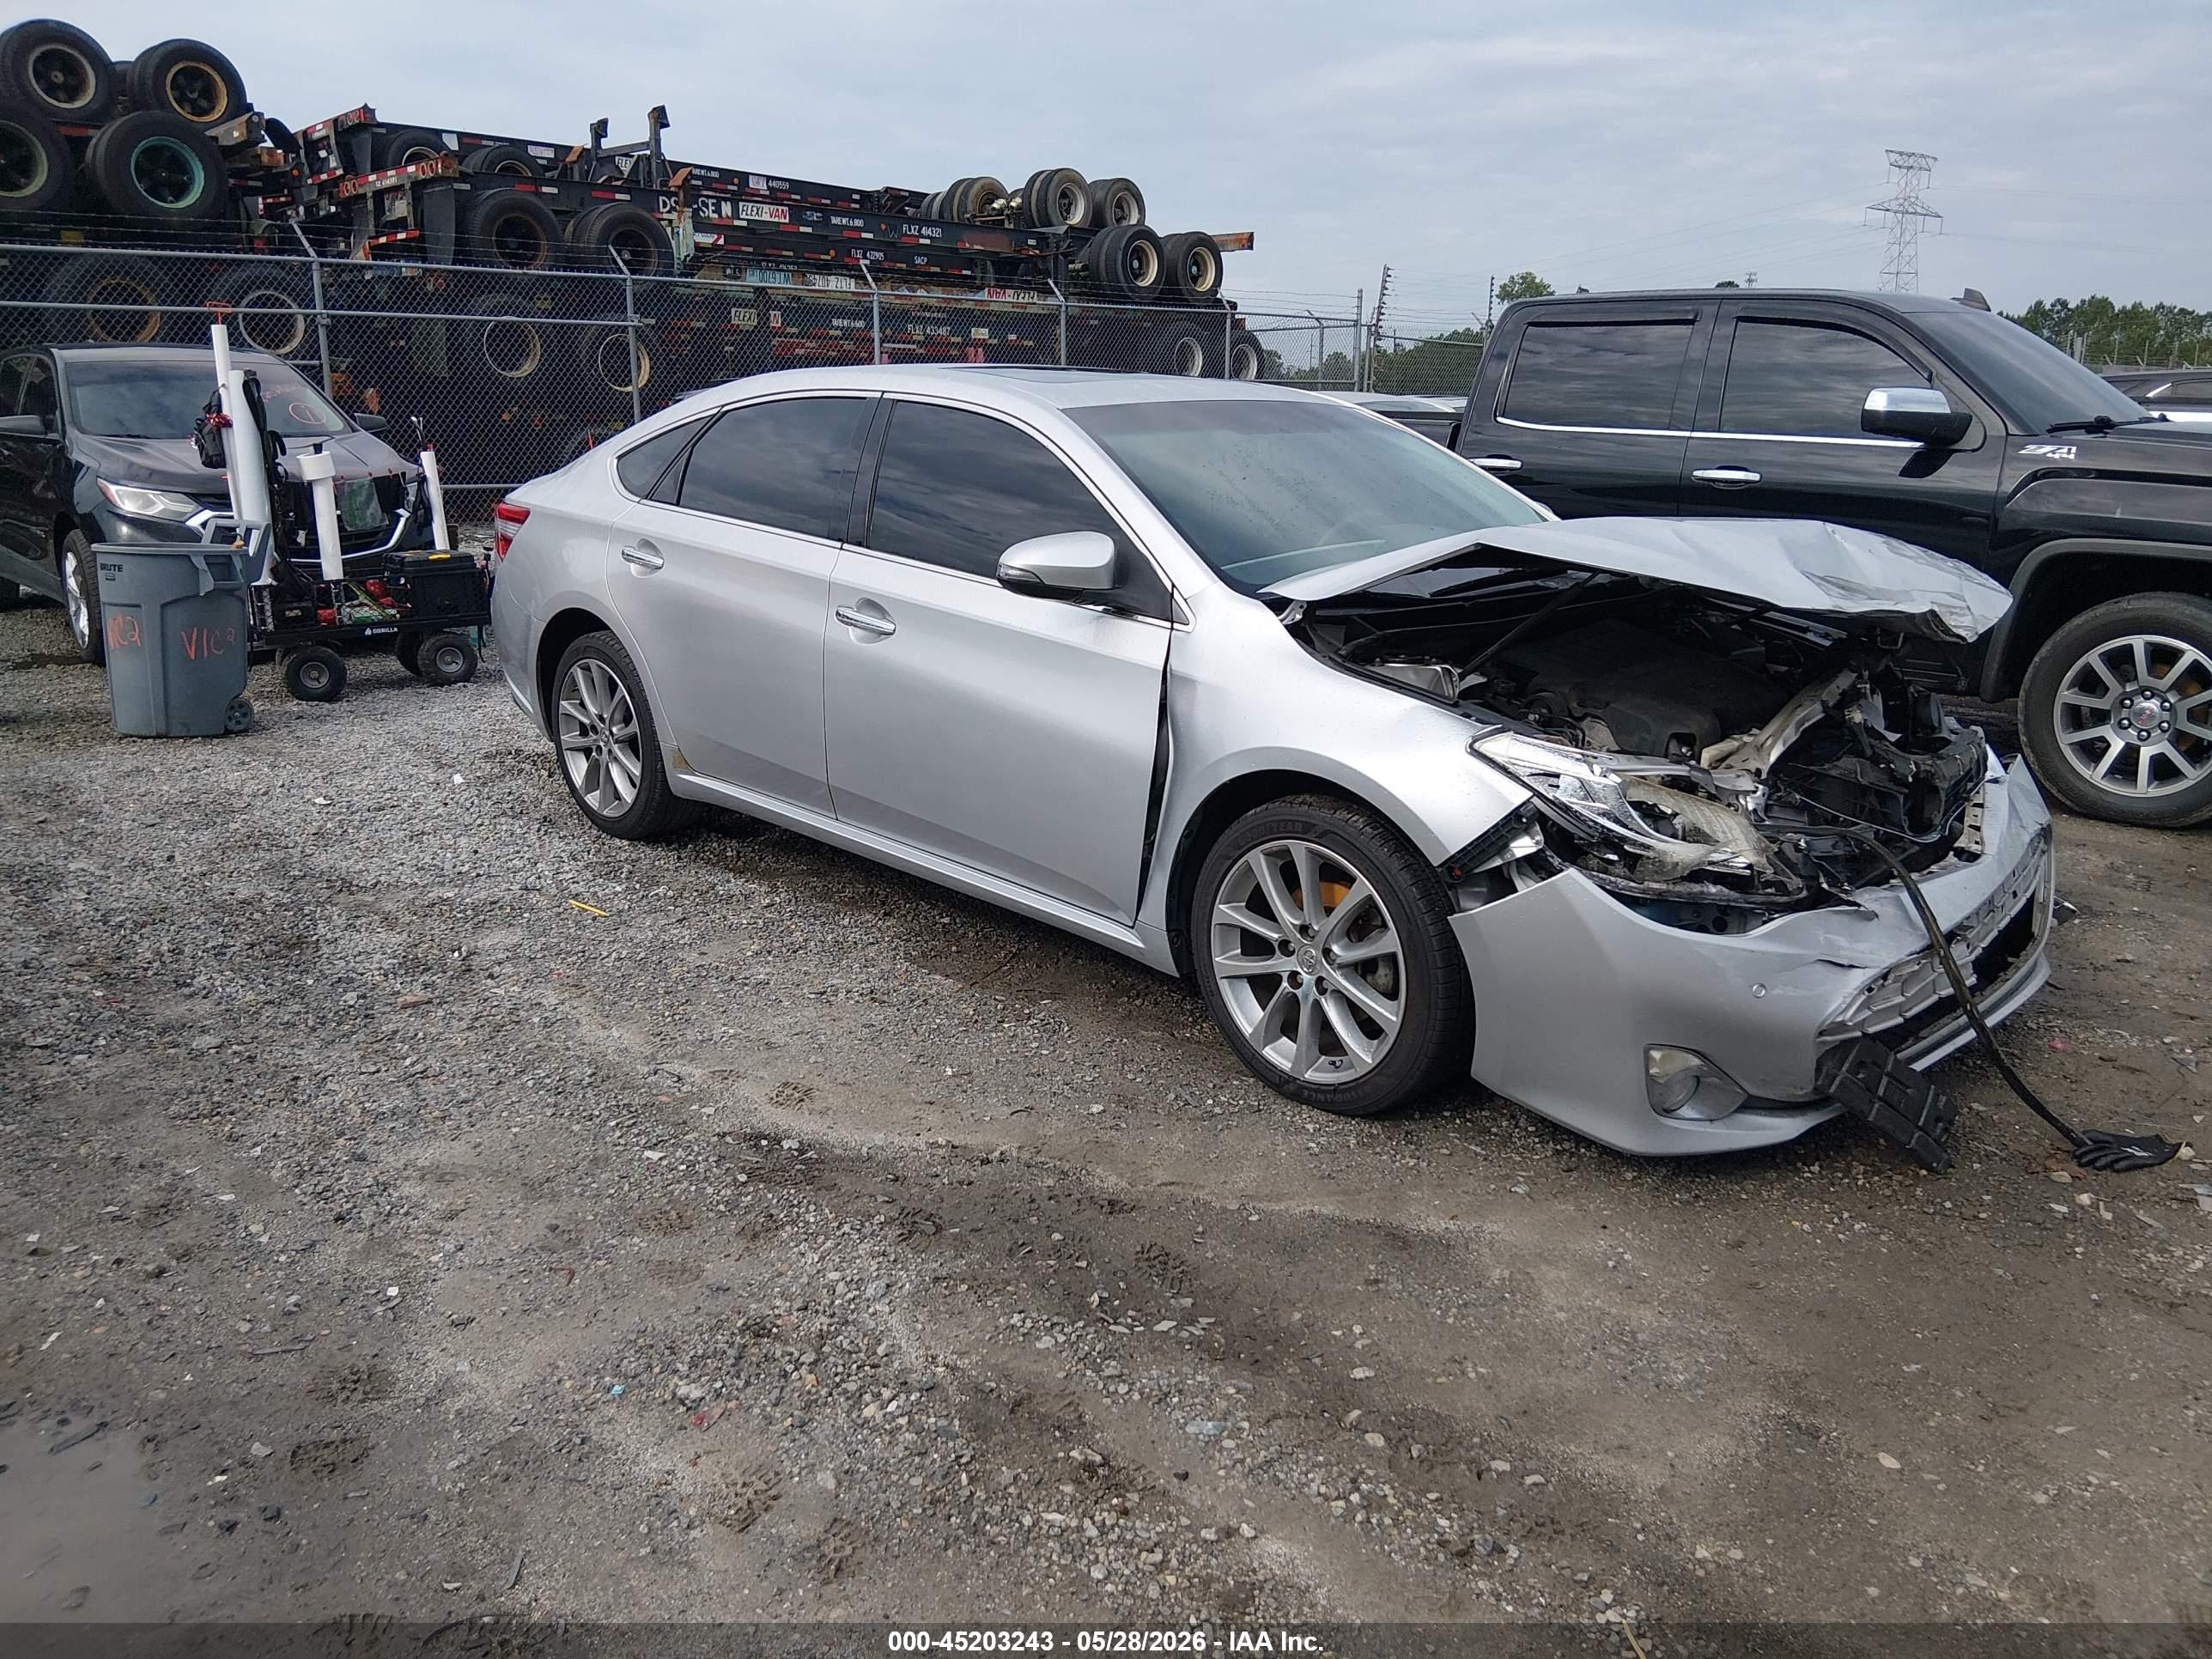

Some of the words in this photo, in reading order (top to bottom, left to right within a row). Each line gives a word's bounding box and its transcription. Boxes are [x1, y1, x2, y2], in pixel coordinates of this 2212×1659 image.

[740, 204, 788, 221] FLEXI-VAN
[902, 224, 919, 236] FLXZ
[921, 226, 942, 238] 414321
[851, 248, 864, 258] FLXZ
[866, 250, 884, 261] 422905
[907, 324, 924, 334] FLXZ
[100, 562, 124, 573] BRUTE
